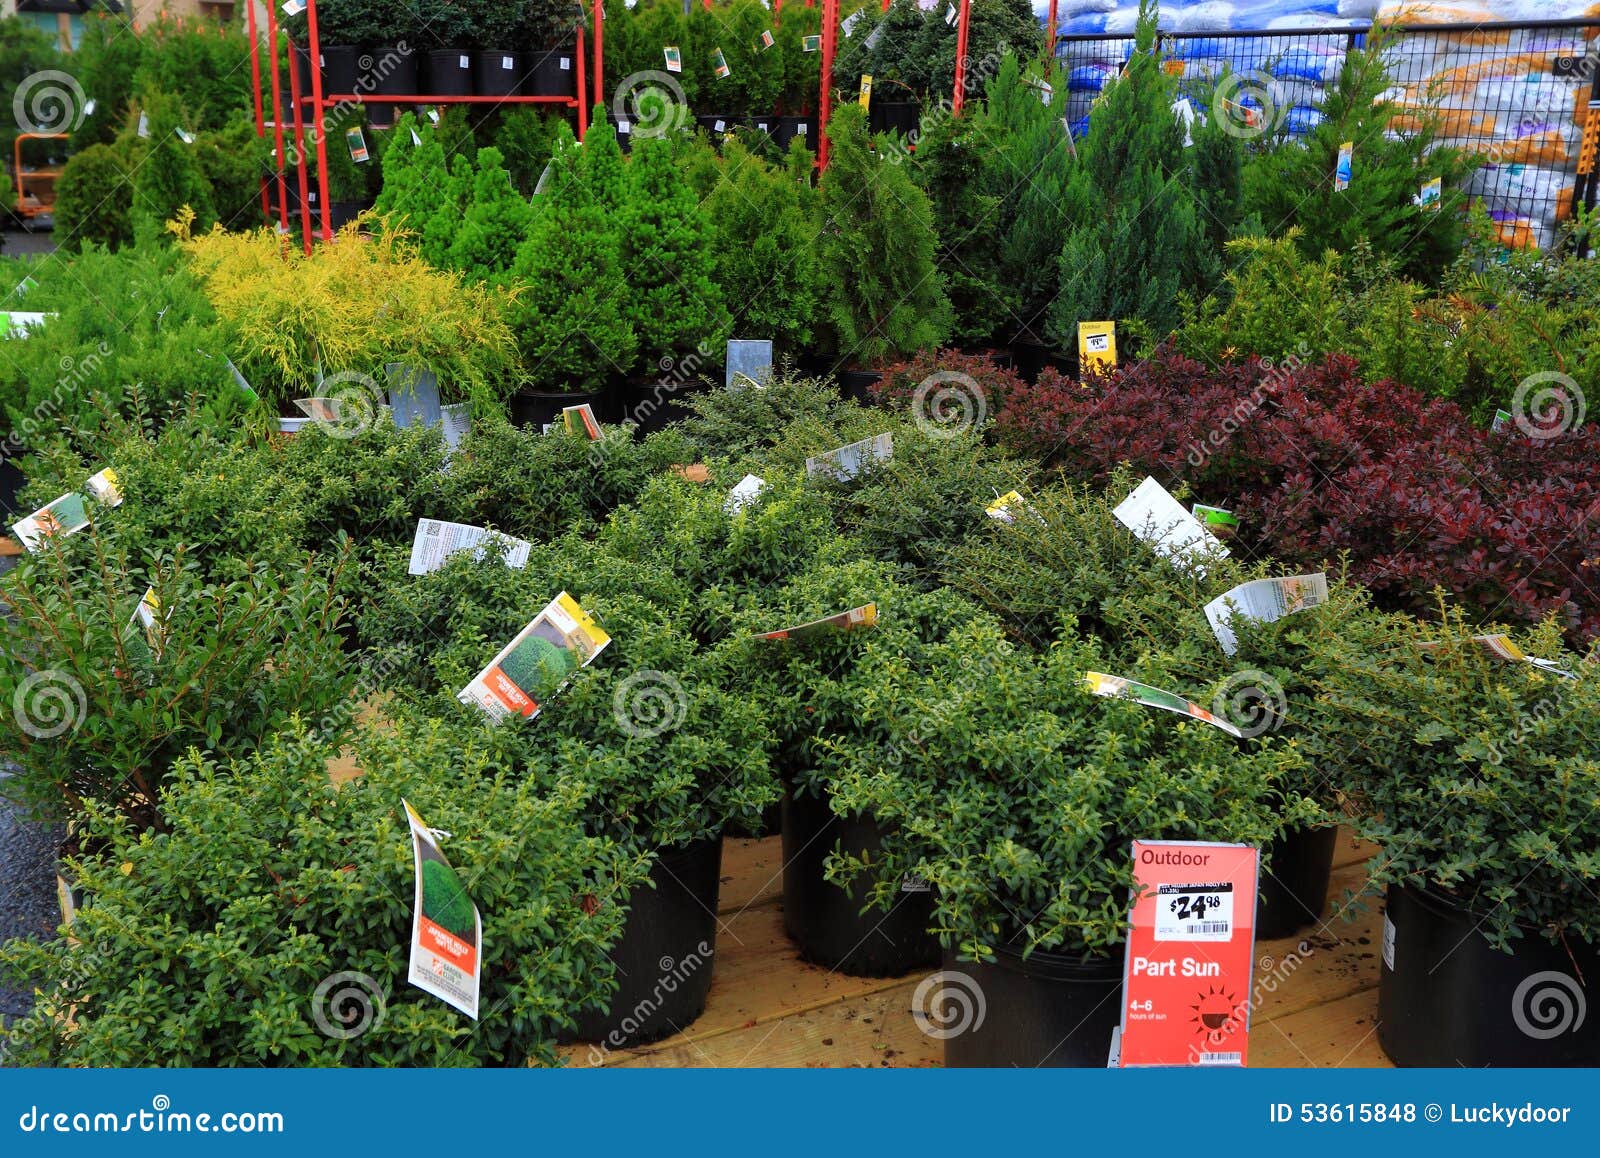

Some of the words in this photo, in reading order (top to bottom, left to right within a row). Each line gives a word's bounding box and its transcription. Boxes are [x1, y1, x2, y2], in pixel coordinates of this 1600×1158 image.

[1141, 850, 1210, 867] Outdoor
[1133, 957, 1176, 977] Part
[1181, 957, 1220, 977] Sun
[1129, 1012, 1148, 1021] hours
[1148, 1012, 1155, 1021] of
[1155, 1013, 1167, 1021] sun
